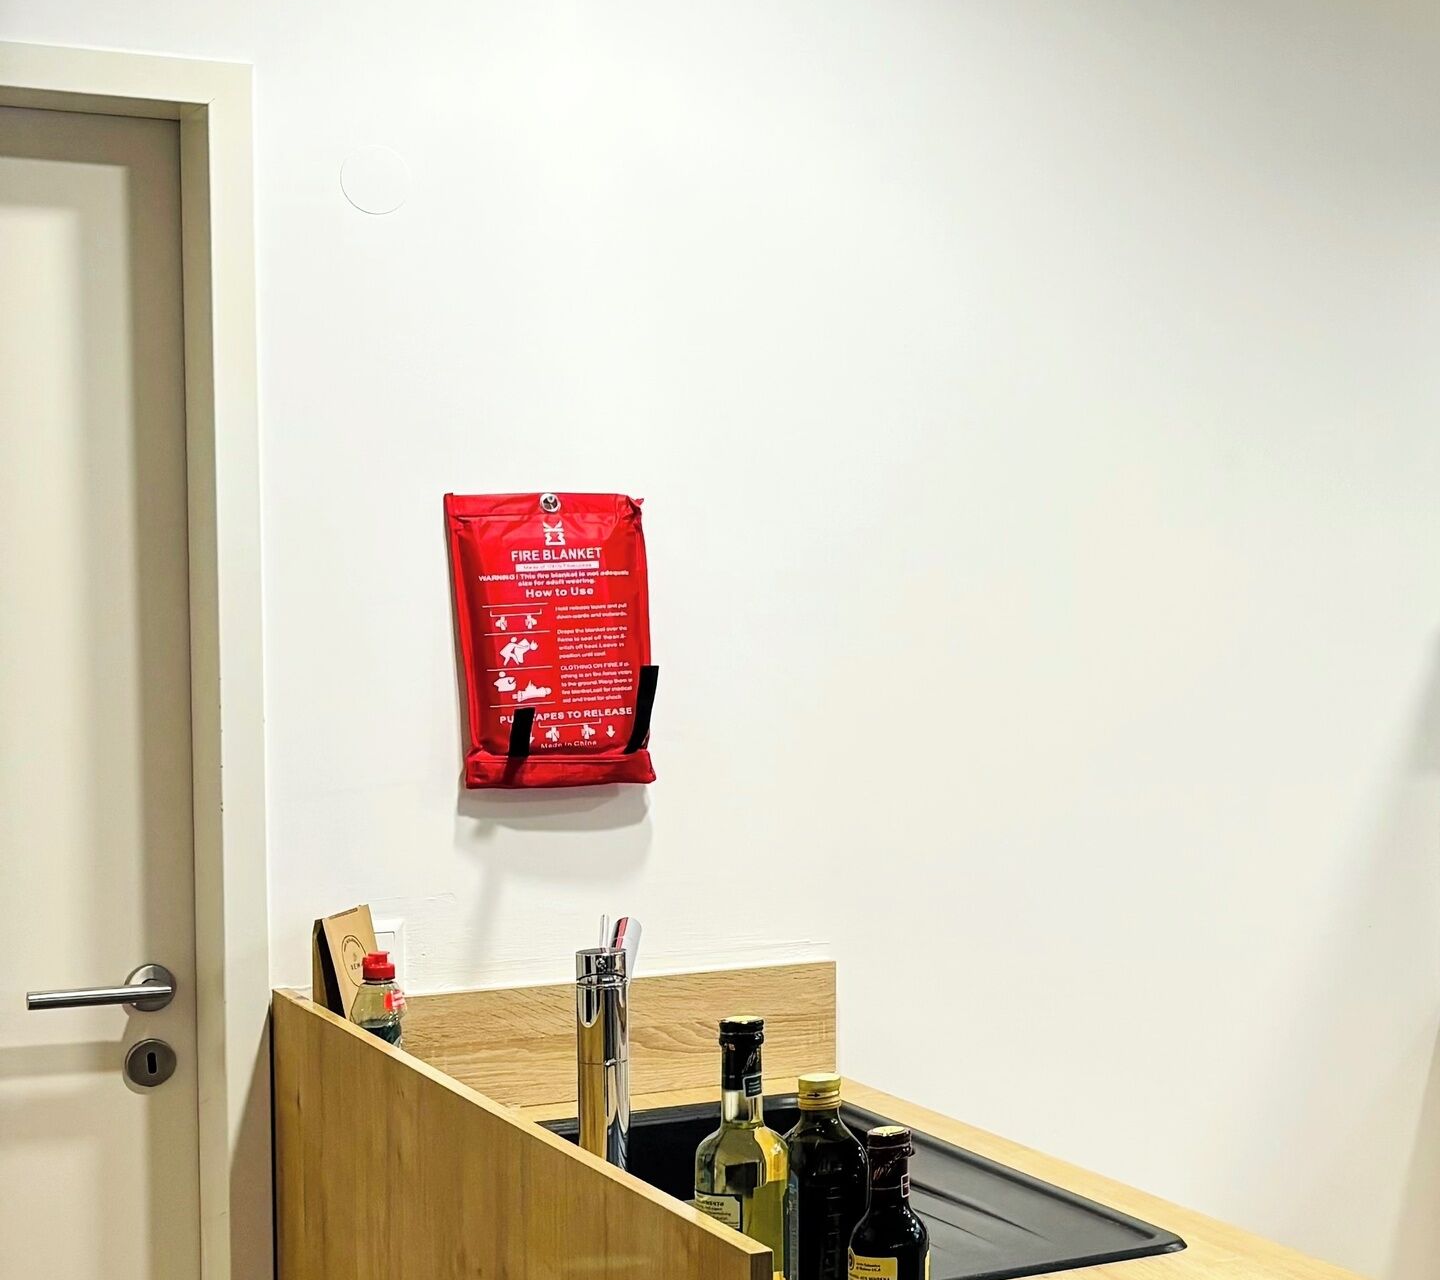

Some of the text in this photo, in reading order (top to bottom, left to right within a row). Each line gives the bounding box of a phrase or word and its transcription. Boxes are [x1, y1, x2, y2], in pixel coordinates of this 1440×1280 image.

[511, 547, 602, 562] FIRE BLANKET
[536, 572, 550, 580] fire
[526, 586, 594, 598] How to Use
[566, 710, 582, 719] TO
[584, 706, 632, 718] RELEASE
